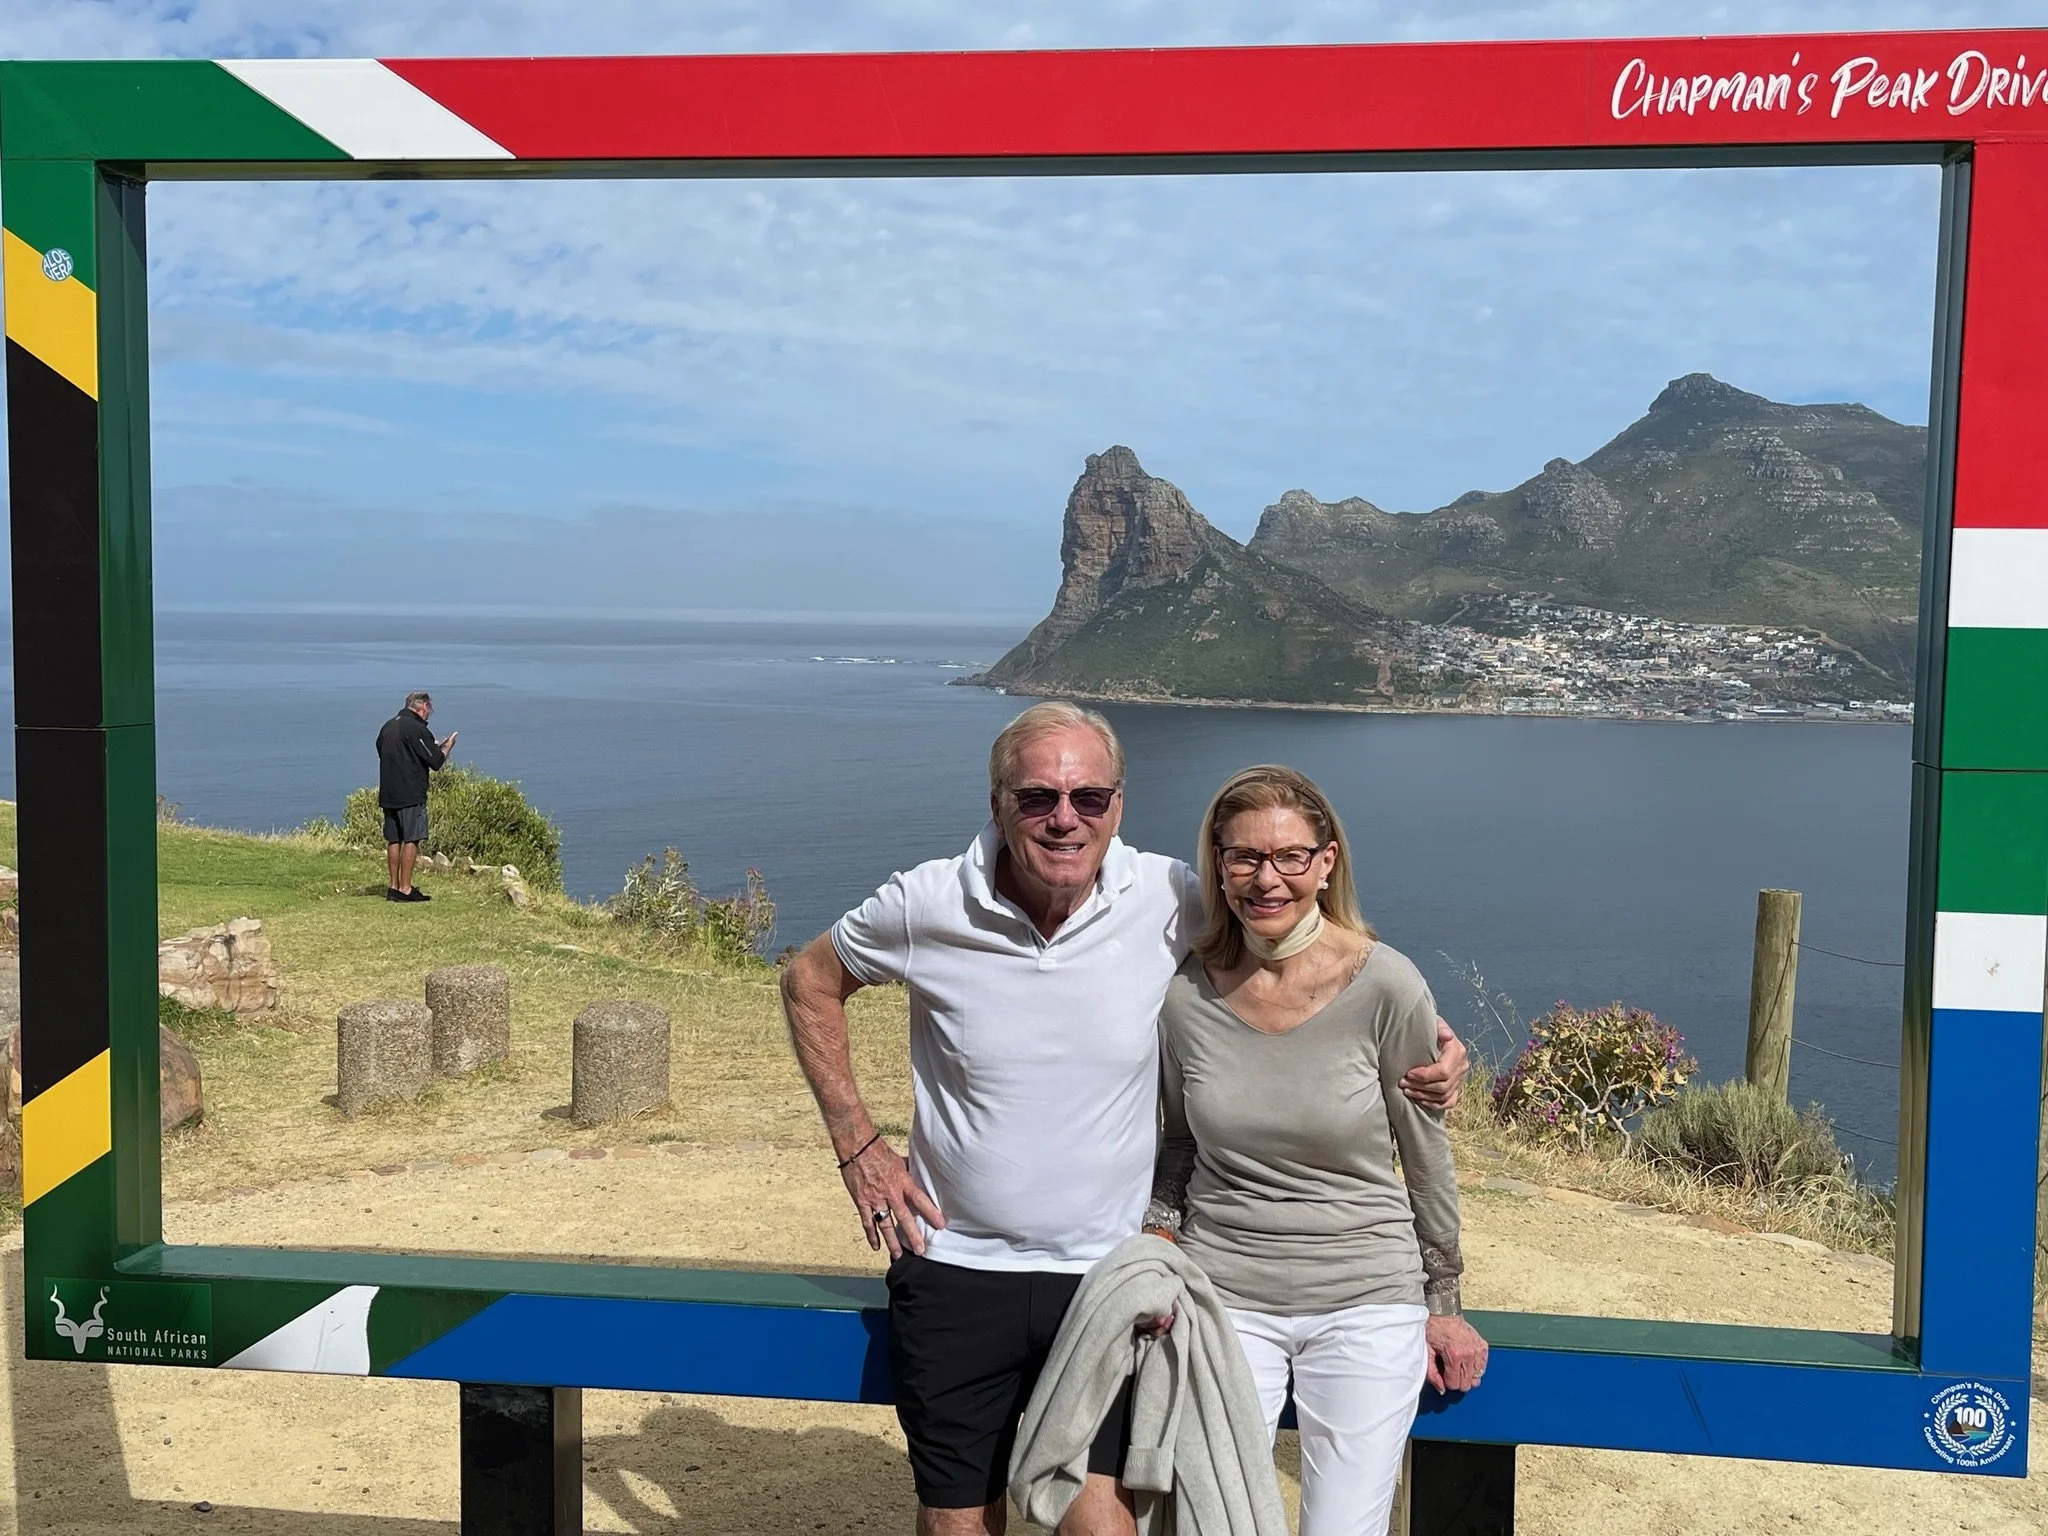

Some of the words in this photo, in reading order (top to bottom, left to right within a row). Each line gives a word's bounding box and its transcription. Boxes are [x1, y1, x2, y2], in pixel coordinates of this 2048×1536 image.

[43, 249, 71, 271] ALOE
[107, 1327, 147, 1343] South
[154, 1330, 207, 1345] African
[107, 1346, 164, 1358] NATIONAL
[170, 1349, 208, 1360] PARKS
[1973, 1382, 1994, 1396] Peak
[1993, 1391, 2010, 1411] Drive
[1954, 1406, 1987, 1428] 100
[1923, 1426, 1955, 1464] Celebrating
[1956, 1458, 1978, 1467] 100th
[1979, 1433, 2016, 1466] Anniversary
